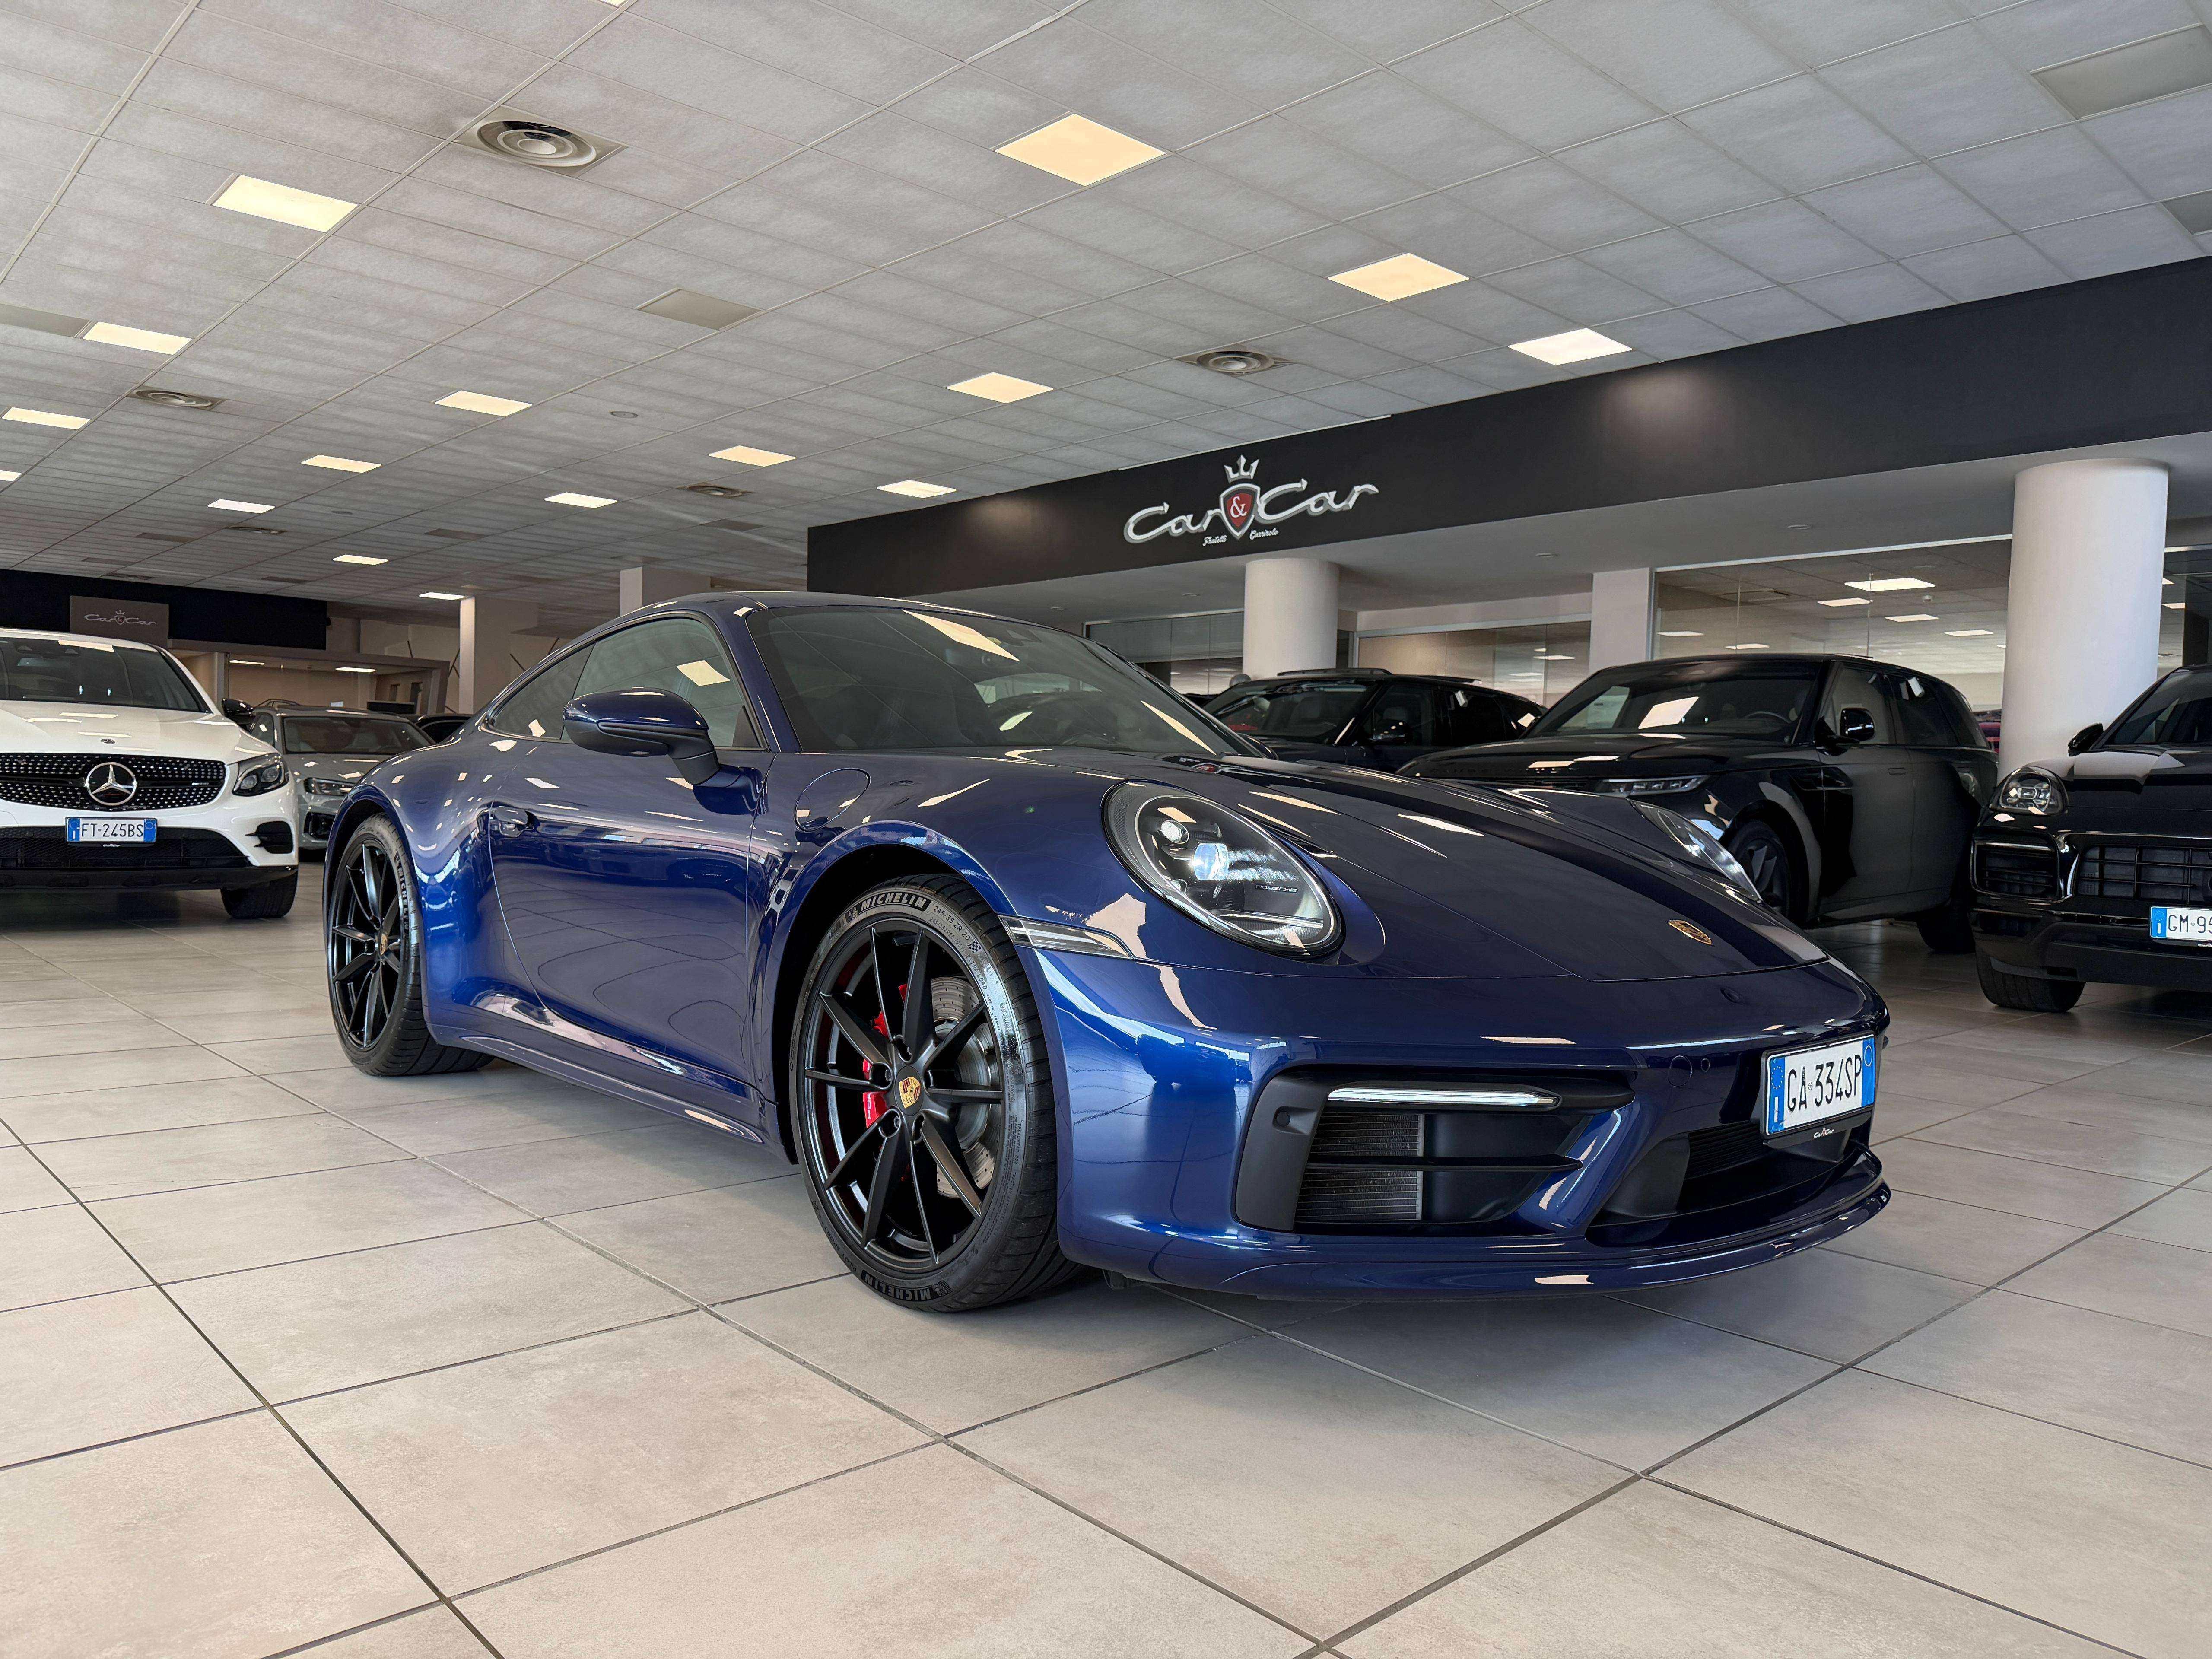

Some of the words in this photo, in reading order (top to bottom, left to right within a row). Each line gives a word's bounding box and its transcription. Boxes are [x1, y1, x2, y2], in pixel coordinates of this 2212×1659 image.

[1123, 502, 1222, 543] Car
[1230, 496, 1248, 519] &
[1255, 478, 1379, 524] Car
[81, 823, 97, 837] FT
[102, 823, 143, 837] 245BS
[860, 893, 927, 912] MICHELIN
[933, 906, 955, 924] 245/35
[953, 922, 963, 932] ZR
[962, 931, 971, 941] 20
[2168, 915, 2189, 933] GM
[965, 954, 979, 973] EXTRA
[977, 973, 988, 990] LOAD
[1787, 1066, 1808, 1113] GA
[1815, 1054, 1862, 1108] 334SP
[842, 1253, 857, 1272] PILOT
[864, 1273, 931, 1300] MICHELIN
